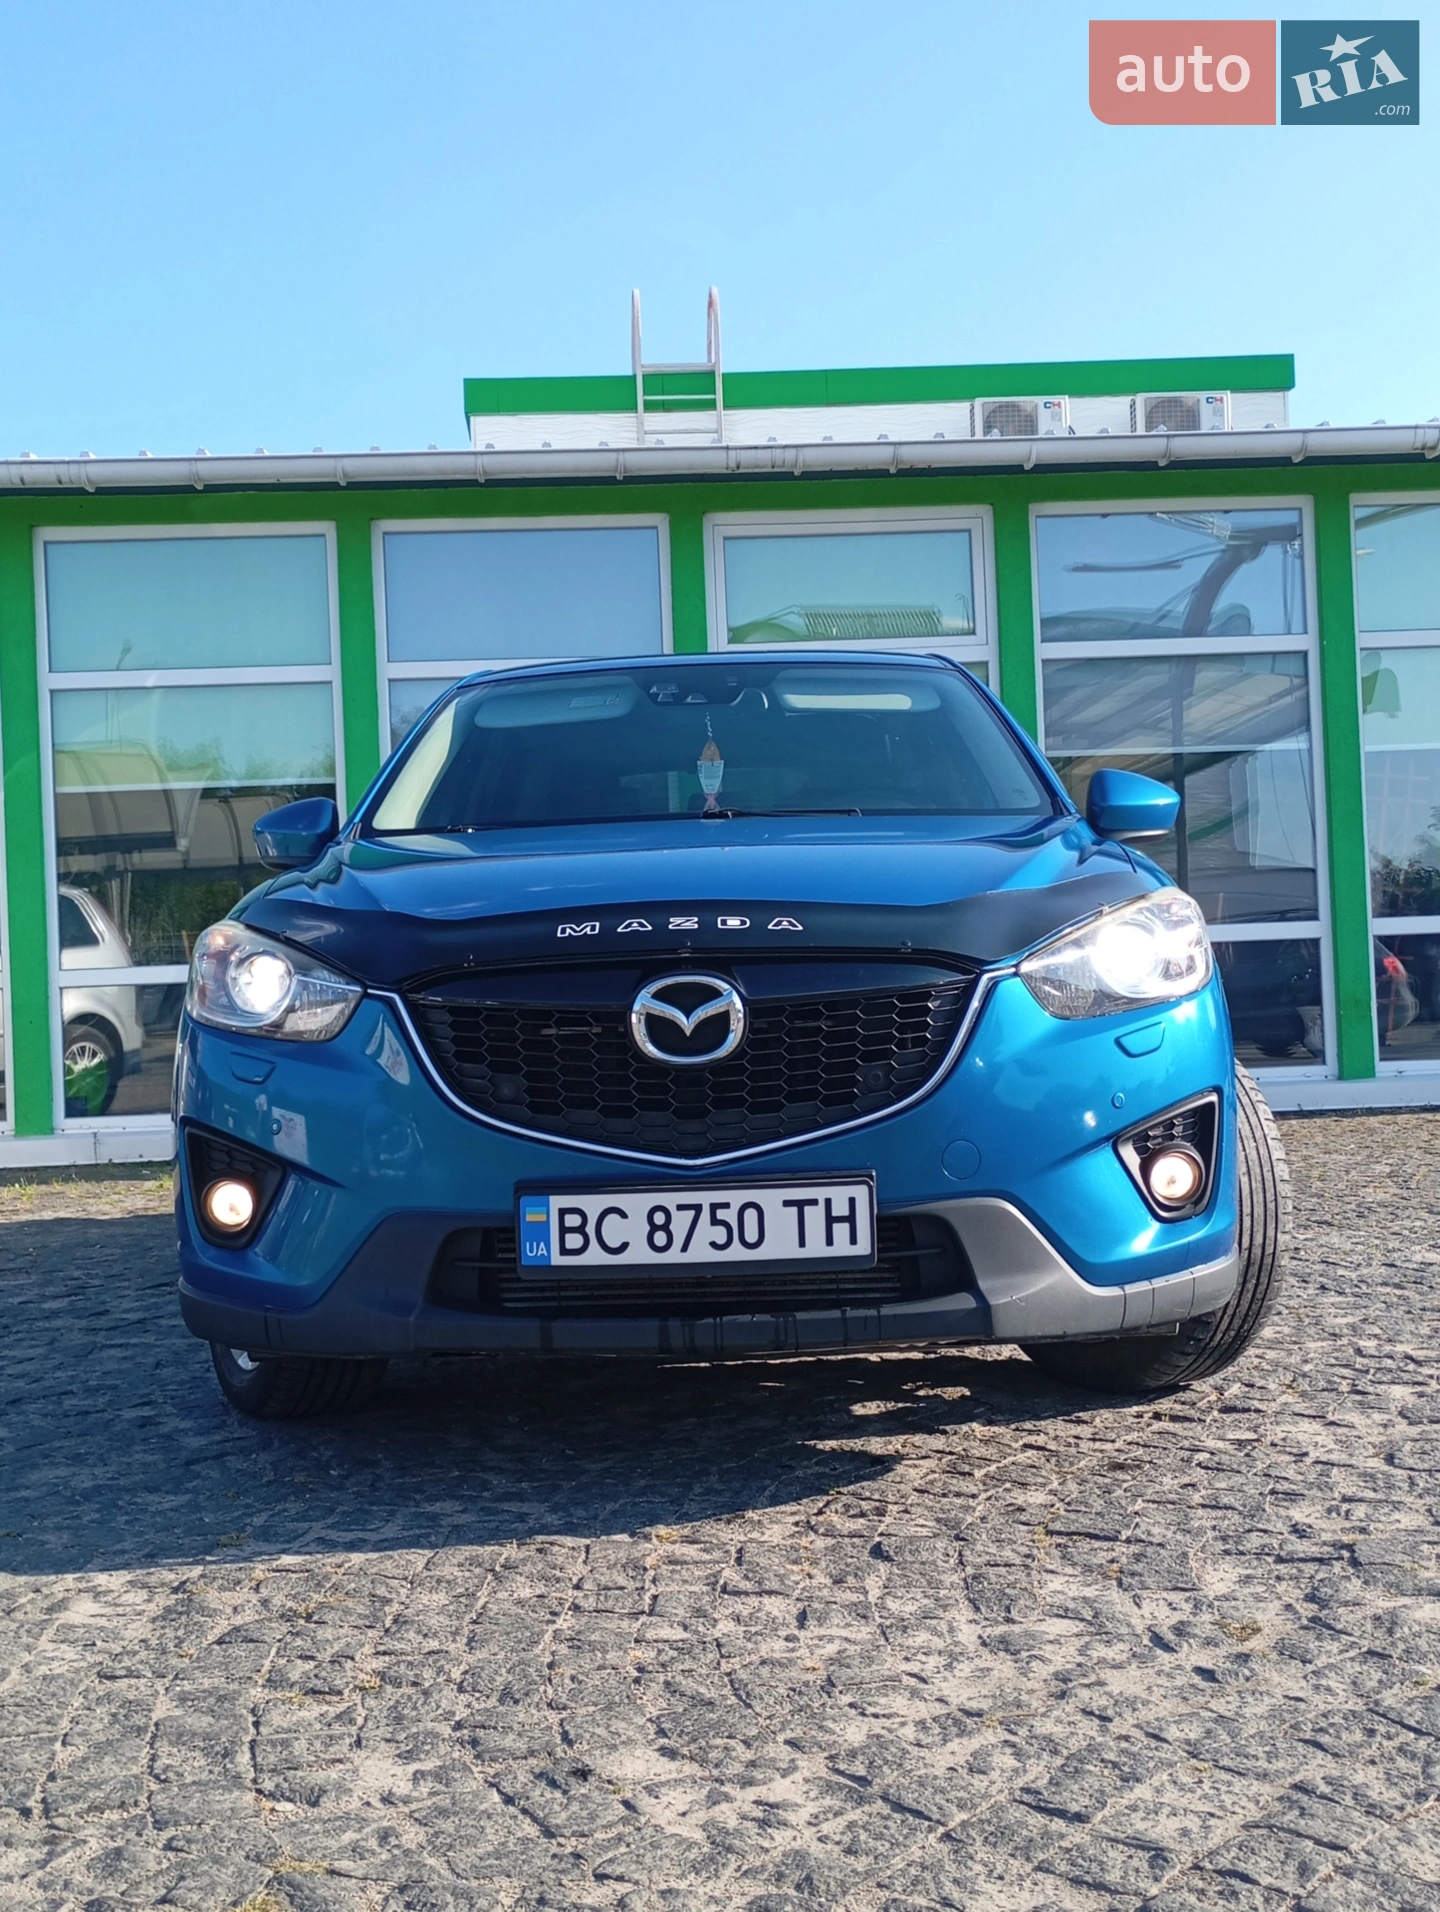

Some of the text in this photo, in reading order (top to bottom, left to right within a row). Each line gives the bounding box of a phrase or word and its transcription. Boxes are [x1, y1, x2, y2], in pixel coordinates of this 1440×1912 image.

[1043, 401, 1062, 409] CH
[1205, 396, 1224, 404] CH
[557, 916, 804, 937] MAZDA
[557, 1196, 858, 1257] BC 8750 TH
[526, 1241, 548, 1257] UA
